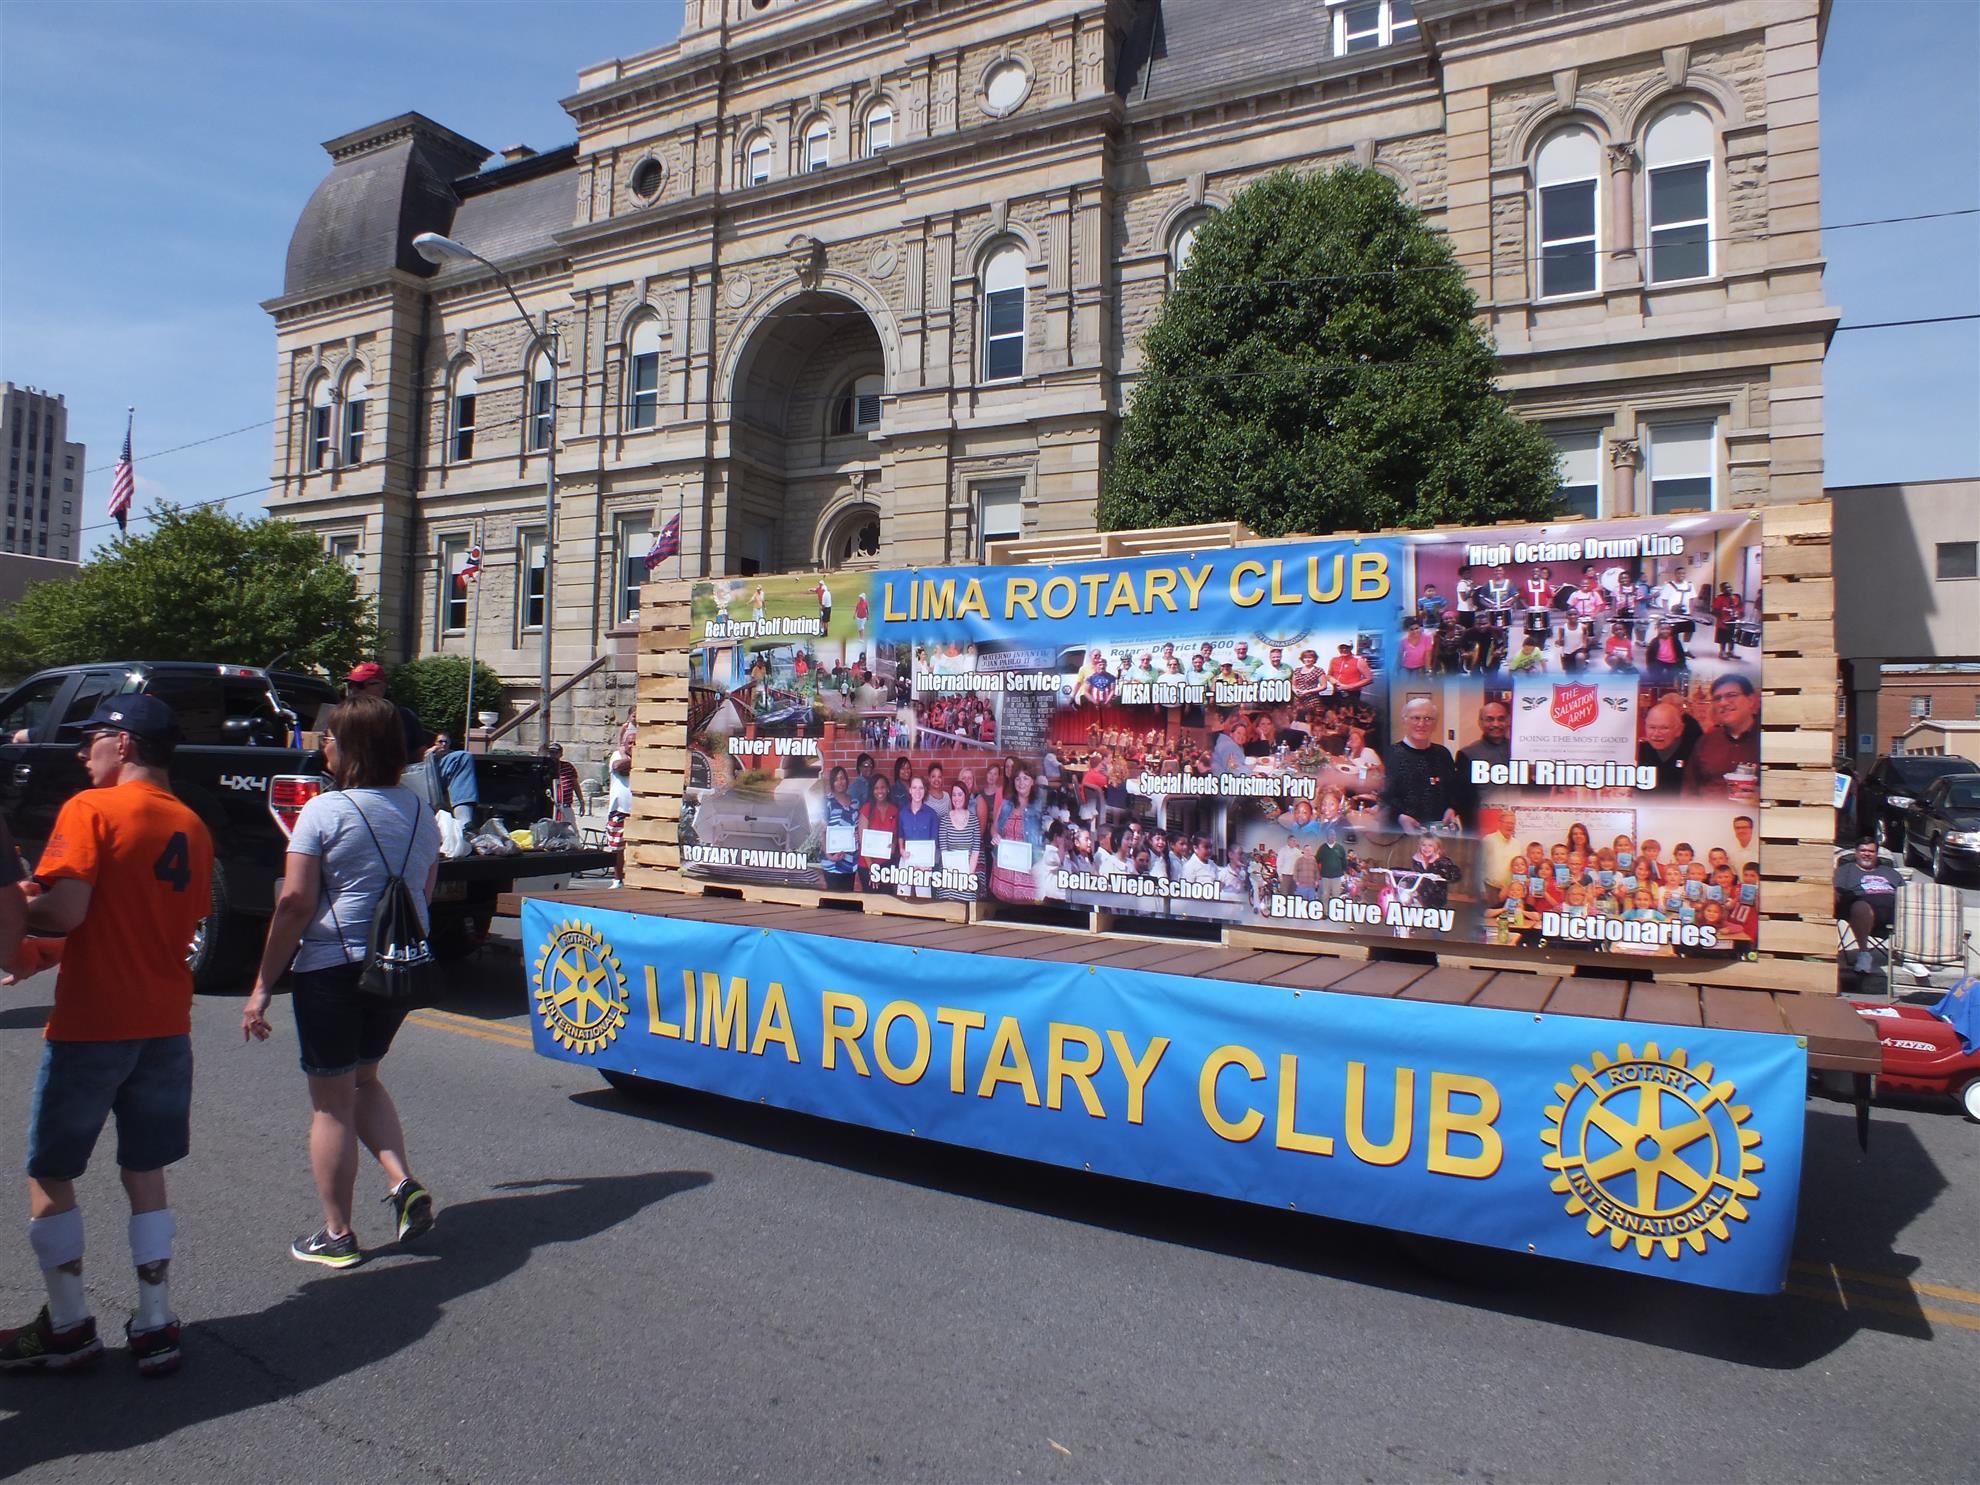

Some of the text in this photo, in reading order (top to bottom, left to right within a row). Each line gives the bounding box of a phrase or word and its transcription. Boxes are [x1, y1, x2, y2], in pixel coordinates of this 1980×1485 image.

[1469, 533, 1685, 568] High Octane Drum Line
[884, 552, 1391, 622] LIMA ROTARY CLUB
[704, 616, 821, 639] Rex Perry Golf Outing
[1152, 642, 1198, 654] Dirict
[916, 671, 1061, 692] International Service
[1121, 683, 1151, 705] MESA
[1152, 682, 1177, 704] Bike
[1178, 682, 1205, 704] Tour
[1215, 680, 1259, 703] District
[1259, 679, 1292, 703] 6600
[1553, 687, 1595, 725] THE SALVATION ARMY
[728, 737, 818, 756] River Walk
[1520, 735, 1629, 744] DOING THE MOST GOOD
[1140, 771, 1317, 801] Special Needs Christmas Party
[1471, 760, 1659, 790] Bell Ringing
[153, 831, 192, 892] 4
[683, 844, 808, 871] ROTARY PAVILION
[869, 863, 979, 892] Scholarships
[1057, 870, 1221, 901] Belize Viejo School
[1270, 894, 1456, 933] Bike Give Away
[561, 932, 598, 950] ROTARY
[1541, 911, 1718, 949] Dictionaries
[545, 999, 618, 1041] INTERNATIONAL
[644, 965, 1504, 1181] LIMA ROTARY CLUB
[1606, 1064, 1698, 1092] ROTARY
[1570, 1171, 1729, 1234] INTERNATIONAL
